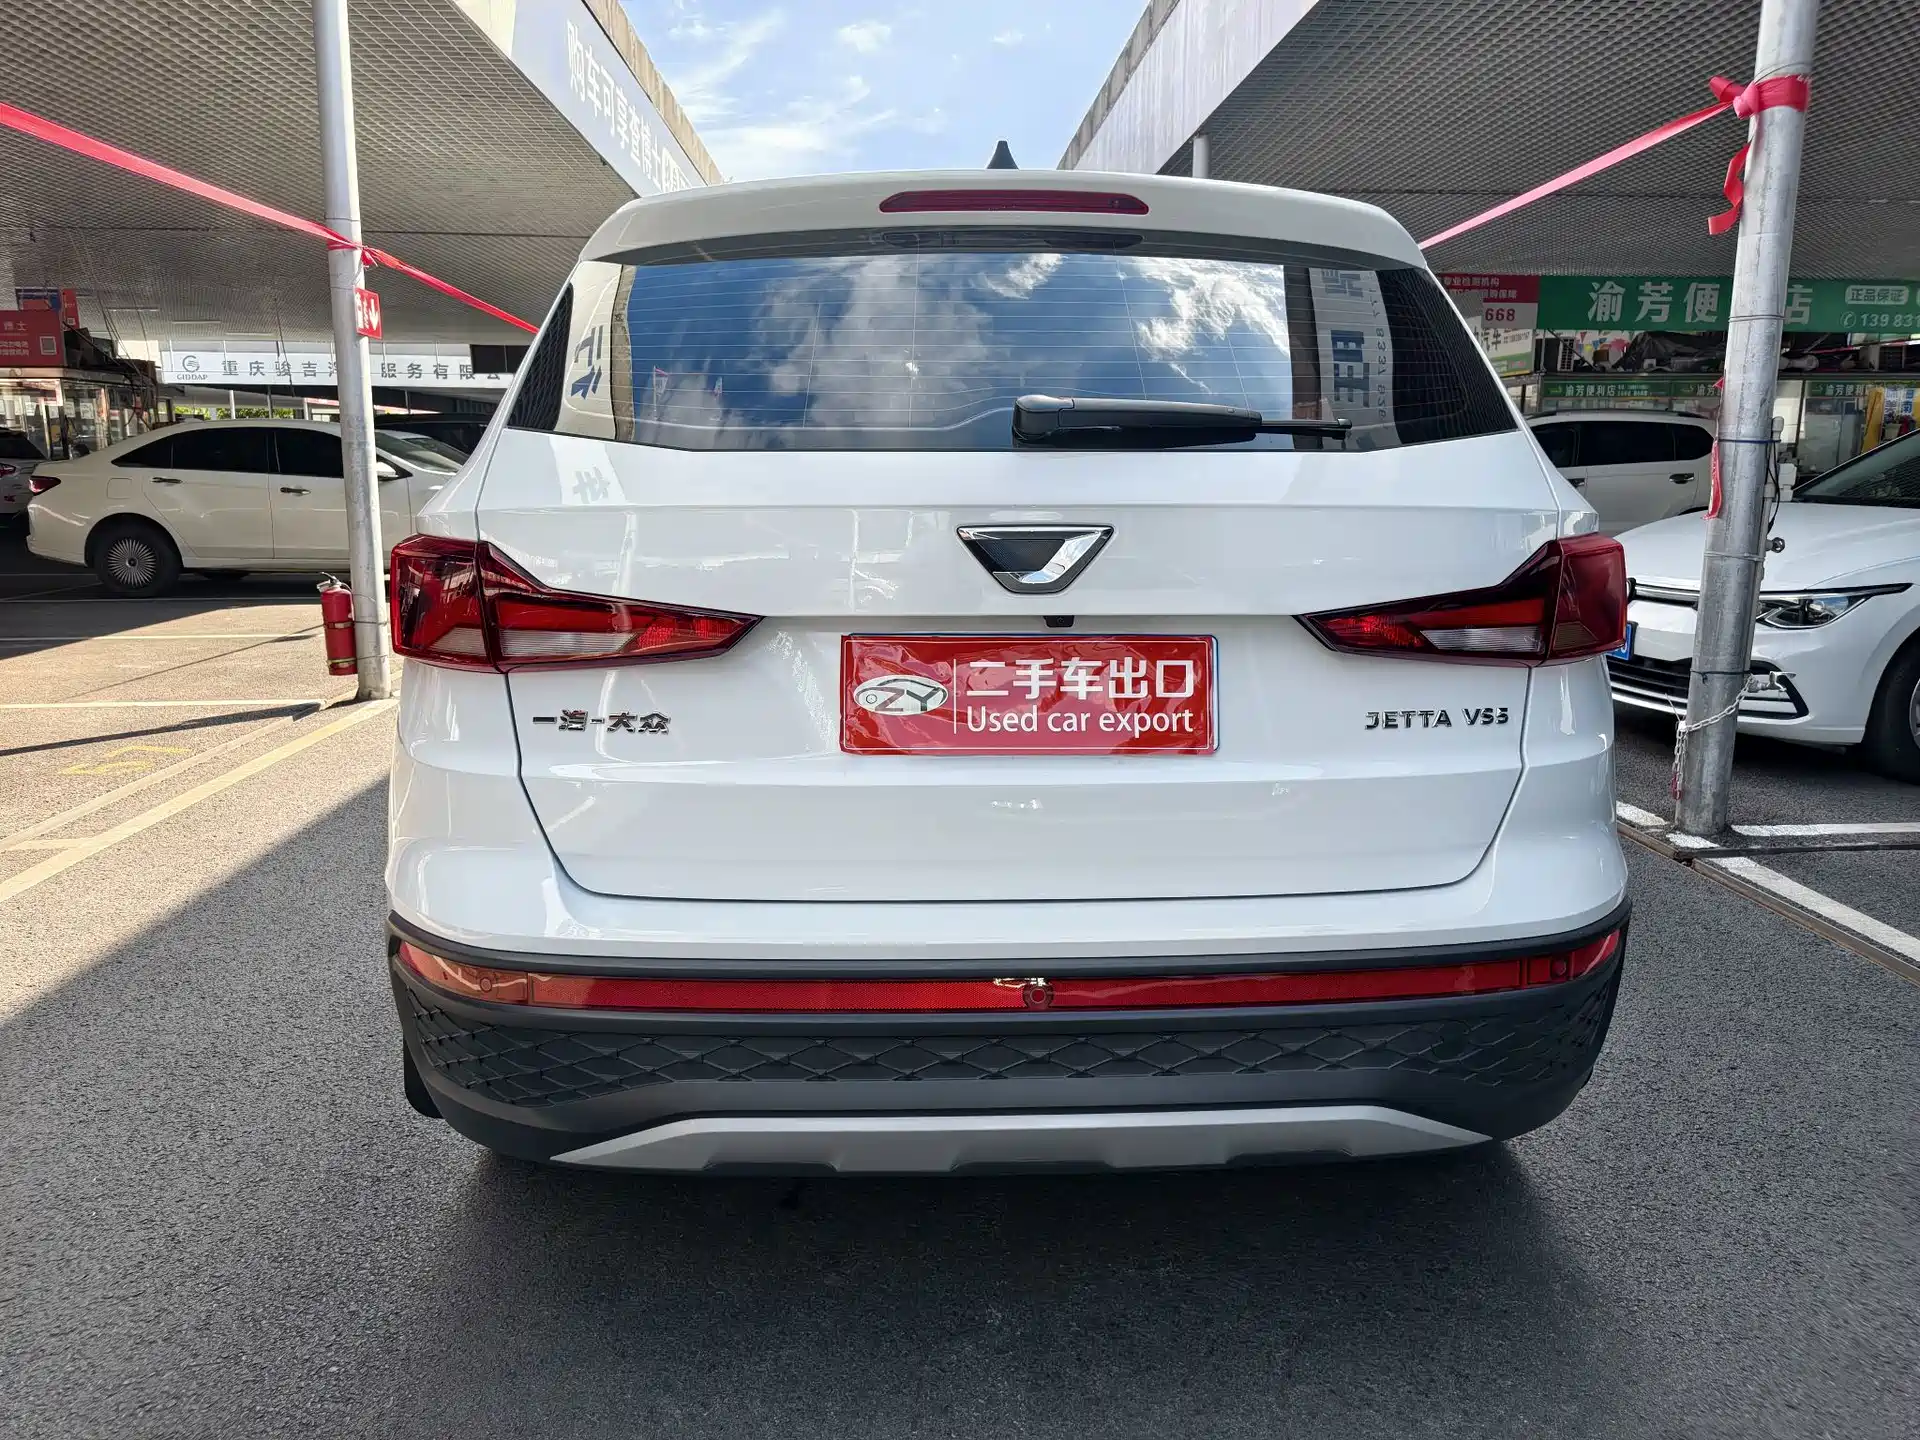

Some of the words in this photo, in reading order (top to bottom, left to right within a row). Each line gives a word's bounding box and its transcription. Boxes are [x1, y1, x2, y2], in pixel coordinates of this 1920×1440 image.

[1587, 281, 1813, 324] 渝芳便店
[1861, 313, 1890, 328] 139
[967, 656, 1195, 700] 二手车出口
[532, 709, 671, 735] 一汽-大众
[967, 705, 1038, 733] Used
[1047, 710, 1090, 733] car
[1099, 707, 1194, 739] export
[1365, 709, 1452, 730] JETTA
[1461, 707, 1510, 726] VS5
